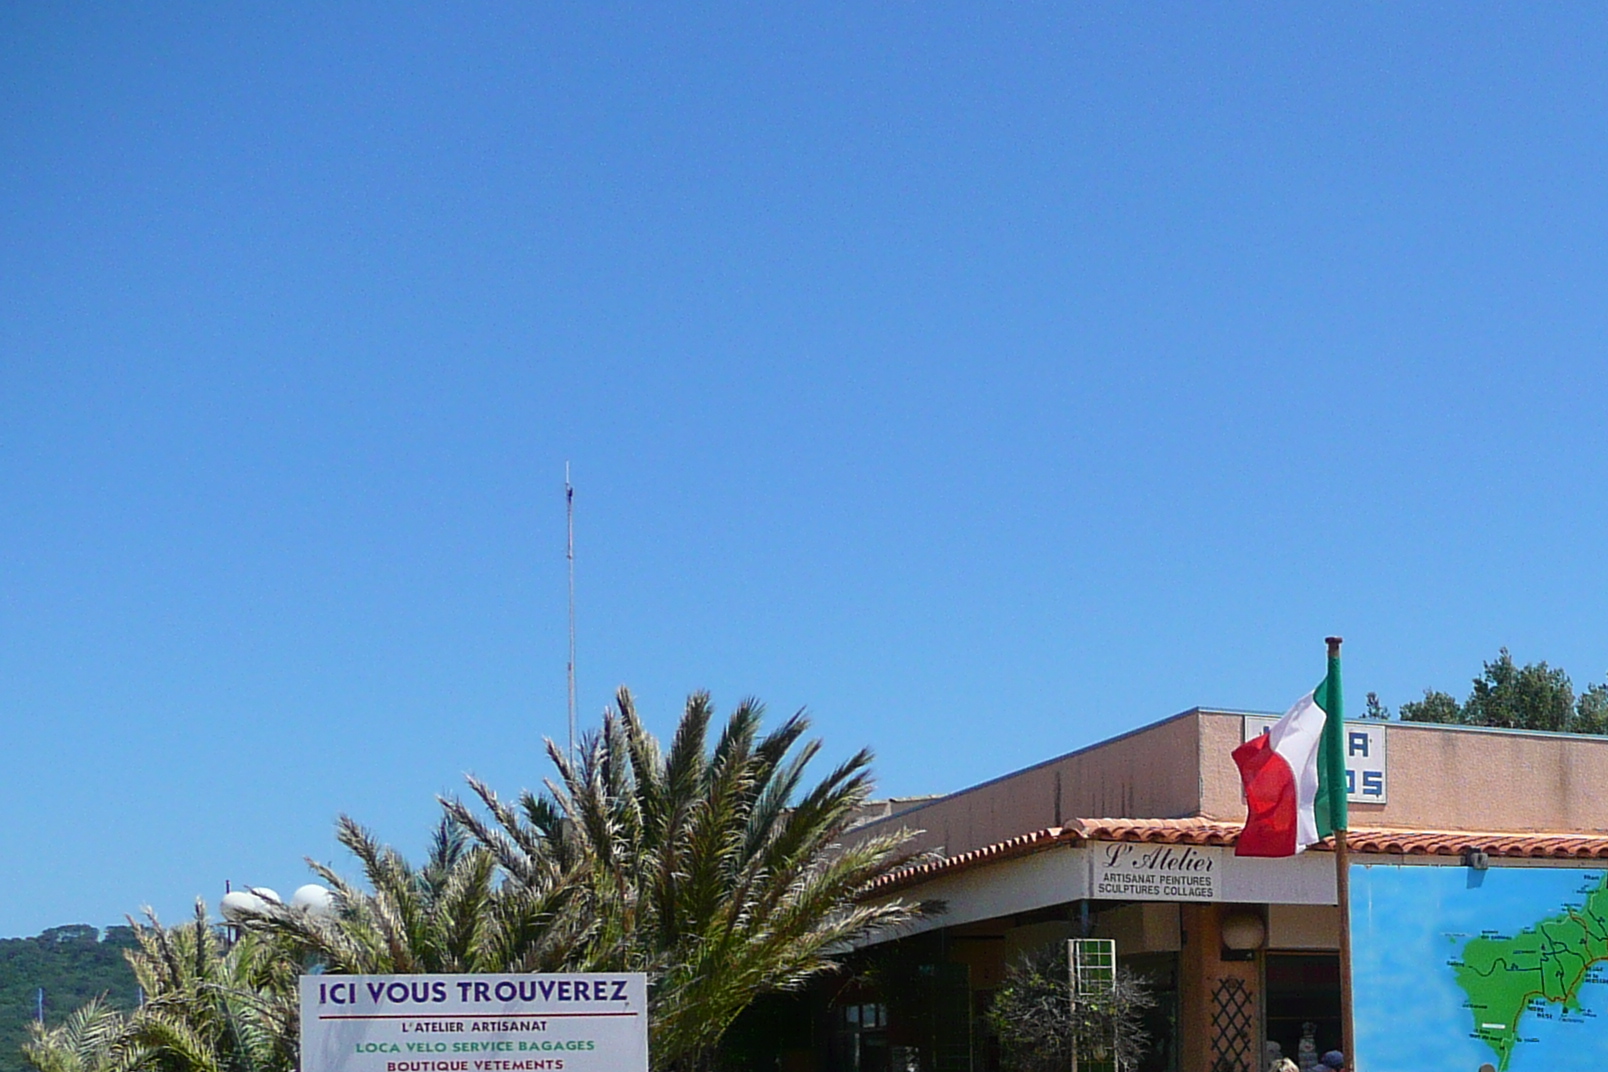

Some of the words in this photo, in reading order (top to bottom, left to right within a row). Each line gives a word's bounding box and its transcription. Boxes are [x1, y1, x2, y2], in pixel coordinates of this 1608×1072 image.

[1103, 872, 1156, 884] ARTISANAT
[1159, 874, 1212, 887] PEINTURES
[1098, 883, 1160, 896] SCULPTURES
[1163, 885, 1214, 898] COLLAGES
[319, 983, 357, 1005] ICI
[367, 981, 448, 1004] VOUS
[457, 979, 629, 1003] TROUVEREZ
[402, 1021, 465, 1033] L'ATELIER
[471, 1020, 548, 1033] ARTISANAT
[356, 1041, 401, 1054] LOCA
[405, 1041, 447, 1053] VELO
[453, 1040, 514, 1053] SERVICE
[518, 1039, 595, 1052] BAGAGES
[387, 1060, 469, 1072] BOUTIQUE
[474, 1058, 565, 1072] VETEMENTS
